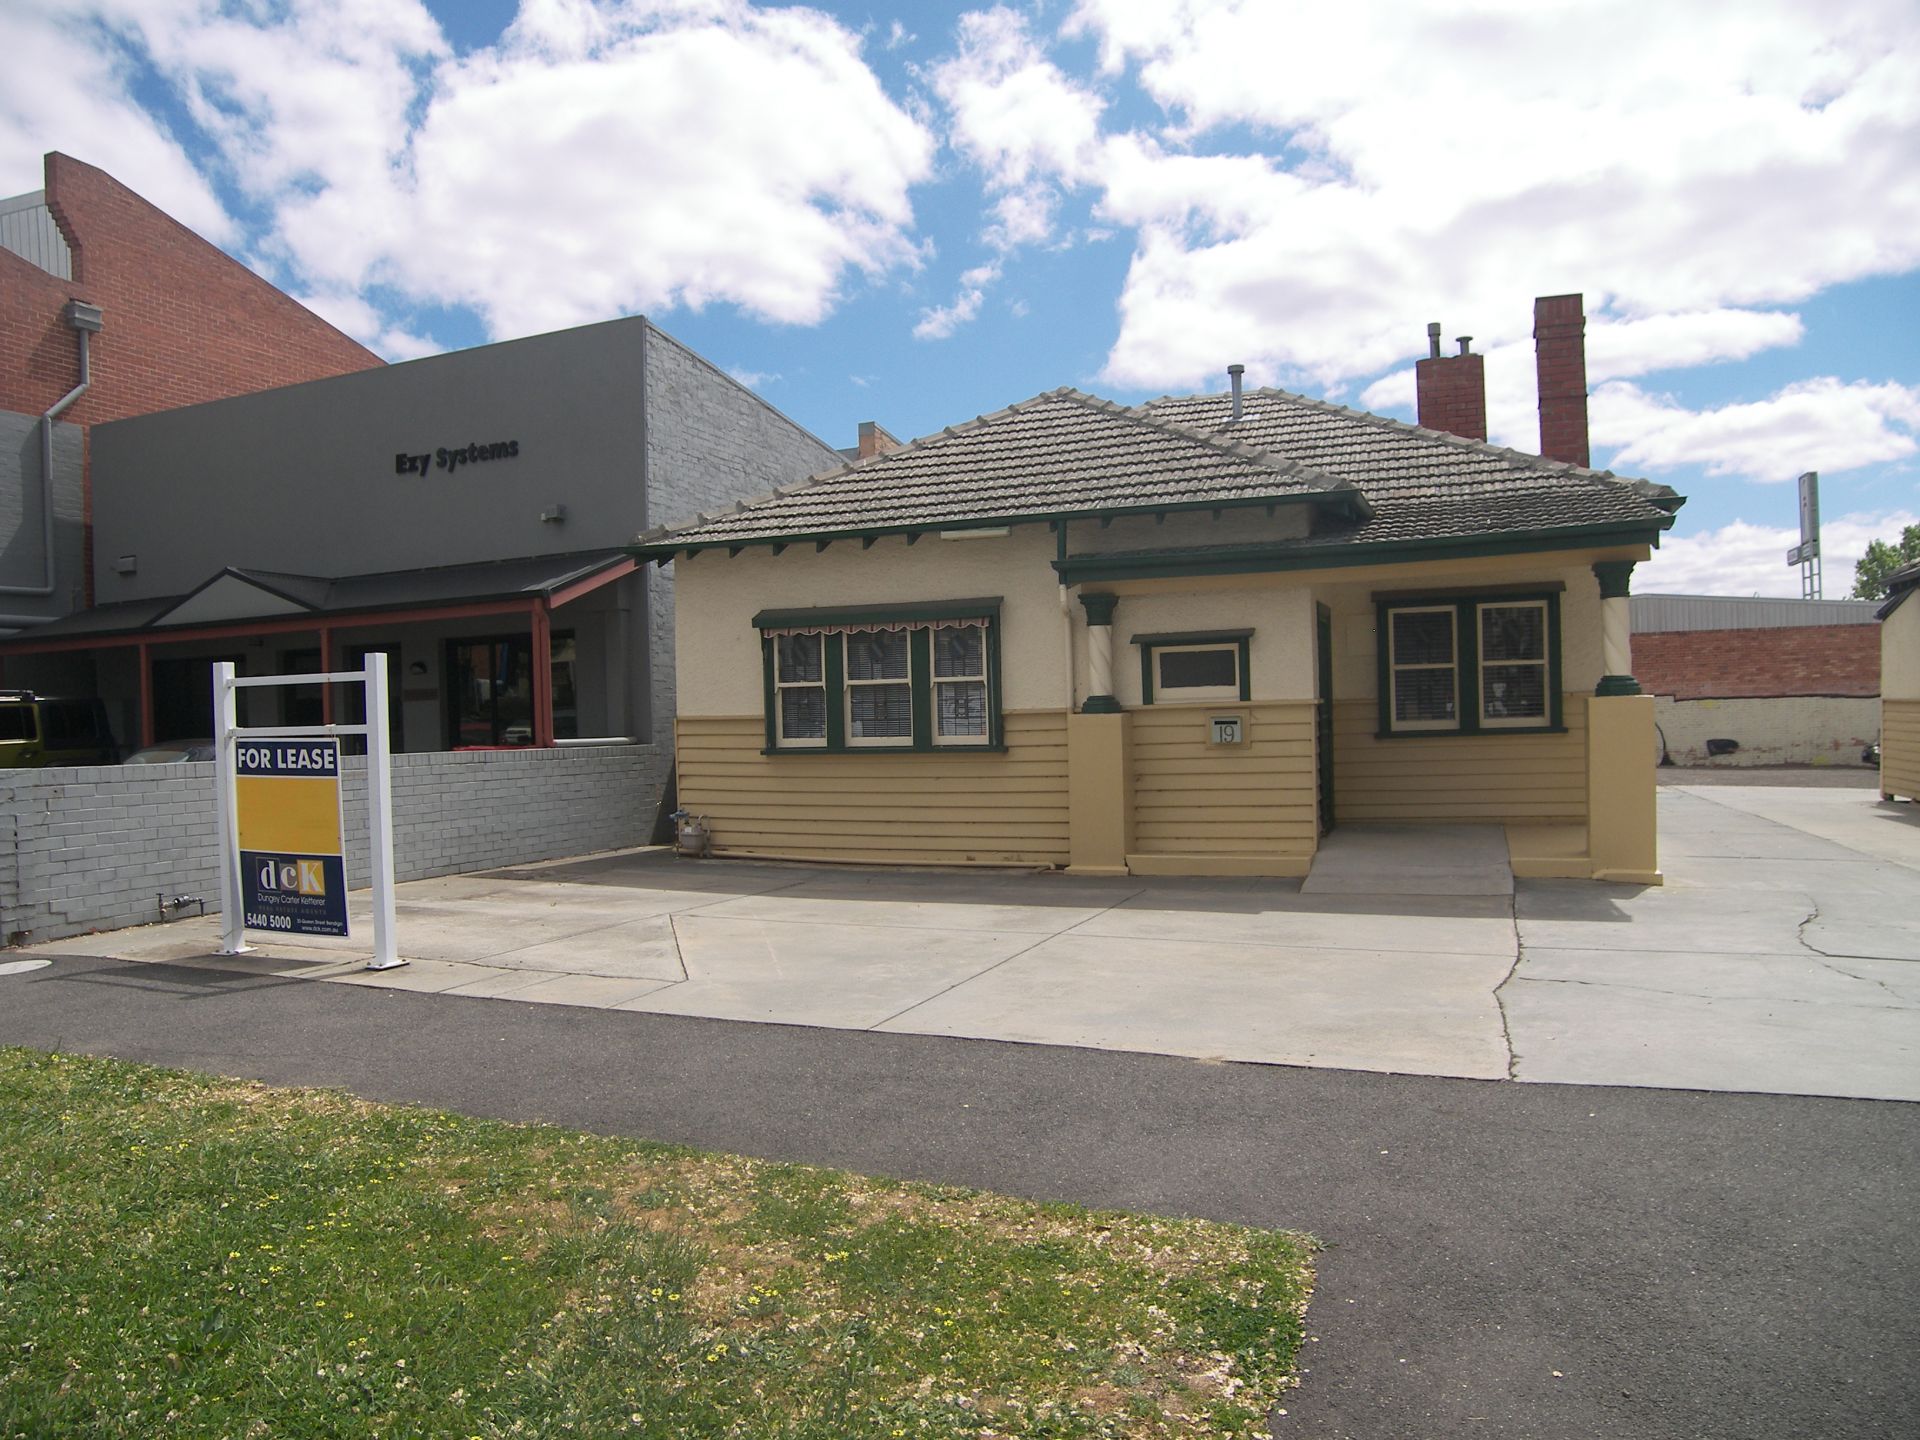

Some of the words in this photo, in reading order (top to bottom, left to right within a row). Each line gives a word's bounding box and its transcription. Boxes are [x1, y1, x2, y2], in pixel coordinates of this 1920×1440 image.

[396, 453, 431, 477] Ezy
[436, 440, 519, 473] Systems
[1219, 725, 1235, 743] 19
[238, 748, 271, 768] FOR
[277, 748, 335, 769] LEASE
[257, 893, 280, 904] Dungey
[281, 895, 300, 904] Carter
[247, 913, 267, 927] 5440
[270, 915, 291, 929] 5000
